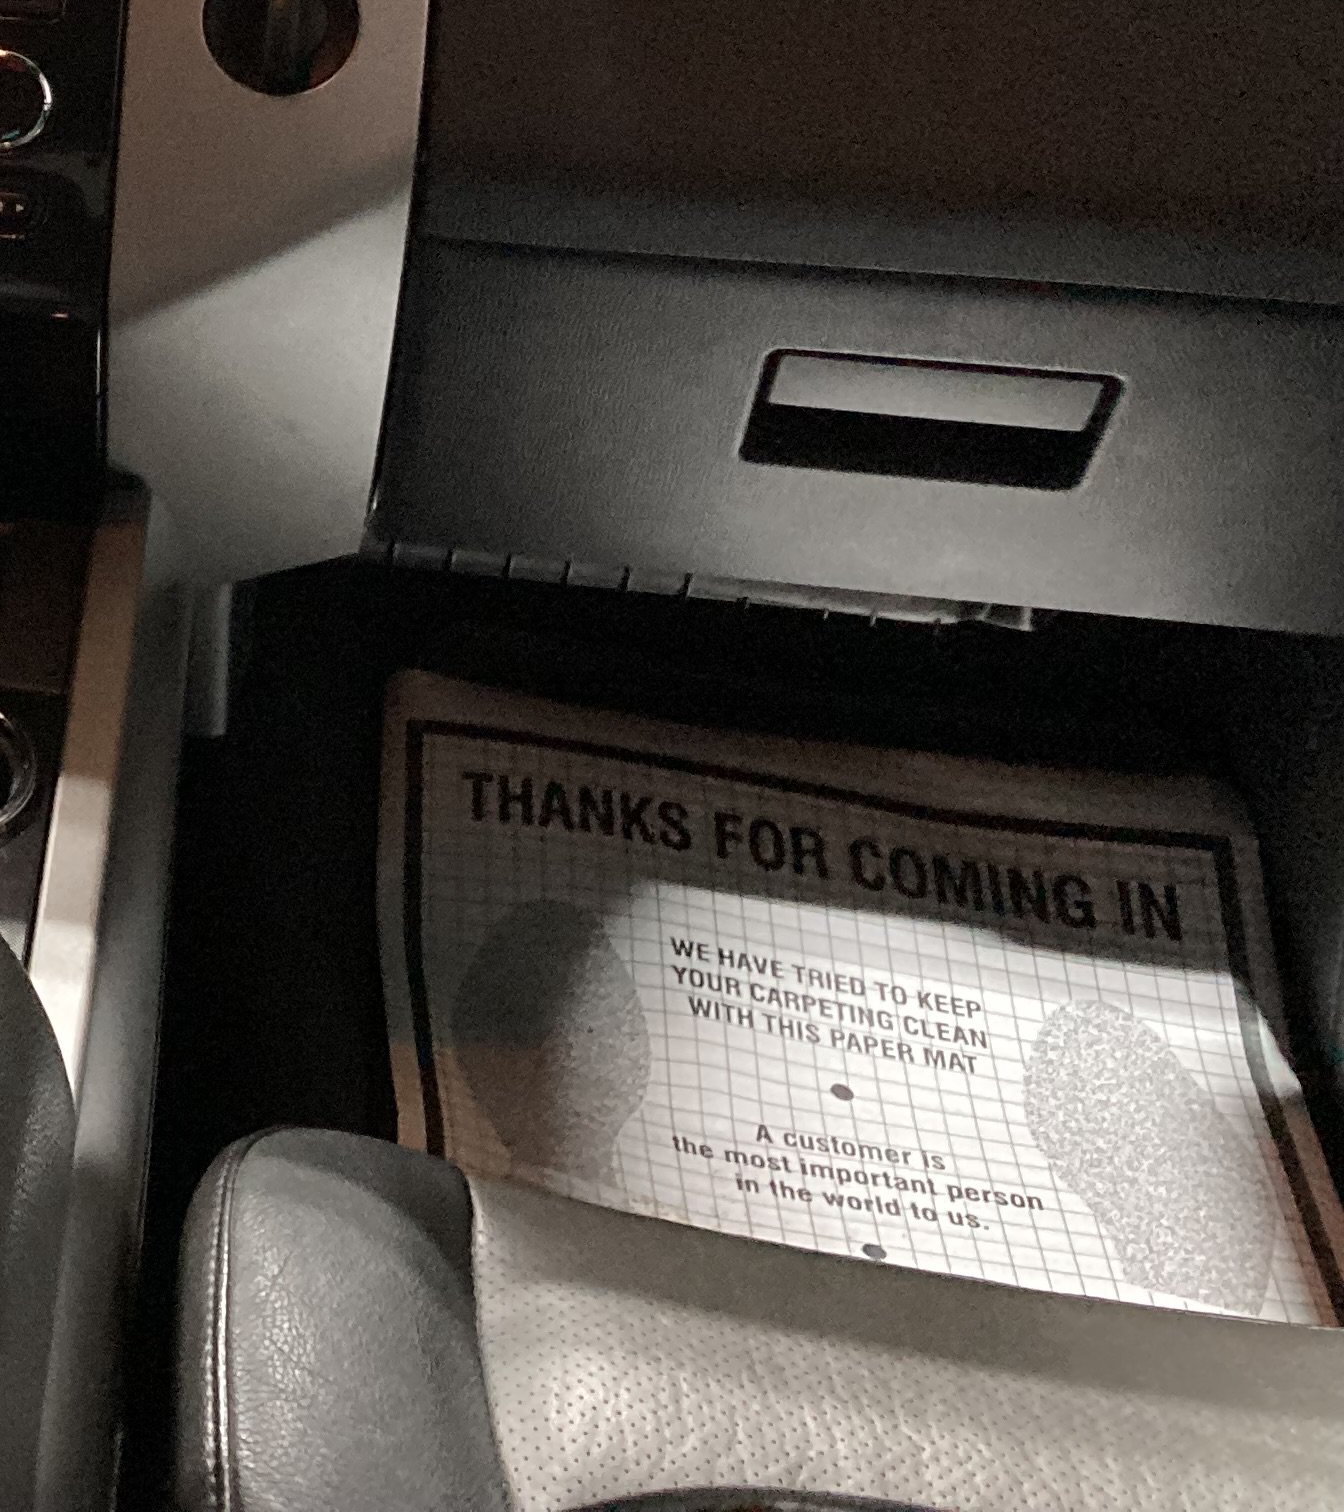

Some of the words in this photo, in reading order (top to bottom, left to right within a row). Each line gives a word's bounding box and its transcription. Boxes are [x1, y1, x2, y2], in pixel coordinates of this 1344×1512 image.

[462, 769, 692, 852] THANKS
[714, 807, 830, 880] FOR
[848, 837, 1096, 929] COMING
[1117, 878, 1183, 941] IN
[670, 936, 710, 960] WE
[718, 948, 784, 979] HAVE
[792, 964, 865, 996] TRIED
[875, 981, 908, 1005] TO
[917, 991, 982, 1019] KEEP
[672, 965, 742, 998] YOUR
[750, 982, 894, 1031] CARPETING
[903, 1015, 988, 1049] CLEAN
[688, 996, 754, 1029] WITH
[762, 1013, 821, 1044] THIS
[830, 1028, 913, 1062] PAPER
[922, 1047, 978, 1075] MAT
[672, 1135, 713, 1160] the
[724, 1148, 792, 1173] most
[800, 1157, 938, 1196] important
[947, 1183, 1045, 1212] person
[756, 1124, 774, 1144] A
[783, 1133, 912, 1164] customer
[921, 1149, 946, 1171] is
[735, 1172, 760, 1194] in
[769, 1178, 812, 1203] the
[822, 1190, 902, 1218] world
[911, 1200, 939, 1223] to
[947, 1209, 991, 1231] us.
